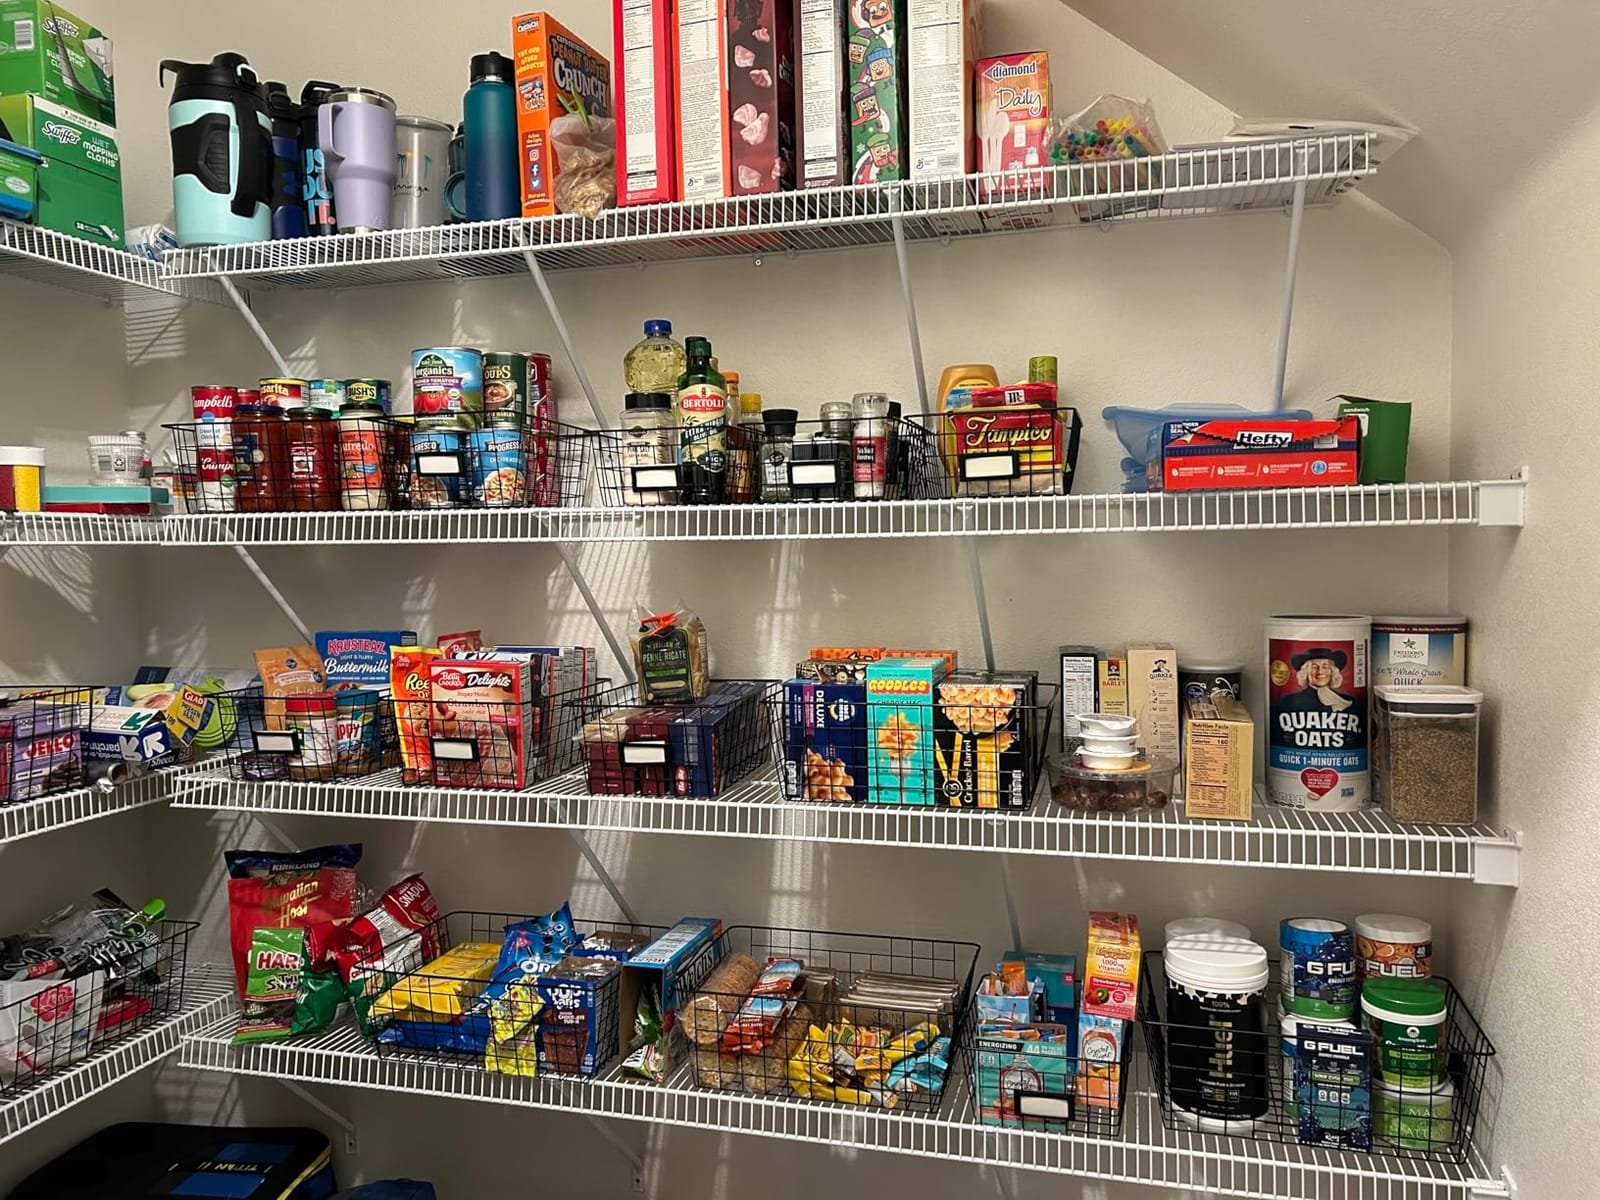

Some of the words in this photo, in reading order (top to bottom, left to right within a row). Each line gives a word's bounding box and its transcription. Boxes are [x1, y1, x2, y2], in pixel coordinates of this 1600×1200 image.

[550, 38, 582, 67] PEANUT
[992, 62, 1035, 78] diamond
[554, 58, 608, 108] CRUNCH
[996, 88, 1041, 116] Daily
[42, 121, 80, 144] Swiffer
[92, 136, 109, 149] WET
[83, 141, 118, 160] MOPPING
[86, 151, 115, 167] CLOTHS
[348, 387, 376, 397] BUSH'S
[683, 399, 724, 408] BERTOLLI
[966, 415, 1053, 446] Tampico
[488, 441, 520, 452] PROGRESS
[1238, 433, 1289, 447] Hefty
[327, 639, 386, 656] KRUSTEAZ
[324, 657, 389, 674] Buttermilk
[1393, 667, 1420, 676] Whole
[438, 679, 464, 687] Crocker
[441, 672, 460, 681] Betty
[467, 673, 511, 688] Delights
[1393, 677, 1423, 685] QUICK
[868, 679, 929, 693] GOODLES
[184, 691, 204, 705] GLAD
[816, 690, 825, 728] DELUXE
[1279, 712, 1359, 732] QUAKER
[1295, 731, 1344, 747] OATS
[1279, 754, 1301, 765] QUICK
[1303, 757, 1342, 766] 1-MINUTE
[1343, 757, 1359, 766] OATS
[272, 862, 320, 871] KIRKLAND
[257, 951, 300, 970] HAR
[1307, 961, 1324, 975] G
[1098, 964, 1122, 973] Vitamin
[1366, 960, 1425, 978] FUEL
[979, 1041, 1017, 1050] ENERGIZING
[1208, 1021, 1233, 1079] Huel
[1304, 1040, 1316, 1050] G
[1317, 1042, 1364, 1056] FUEL
[214, 1163, 257, 1172] TITAN
